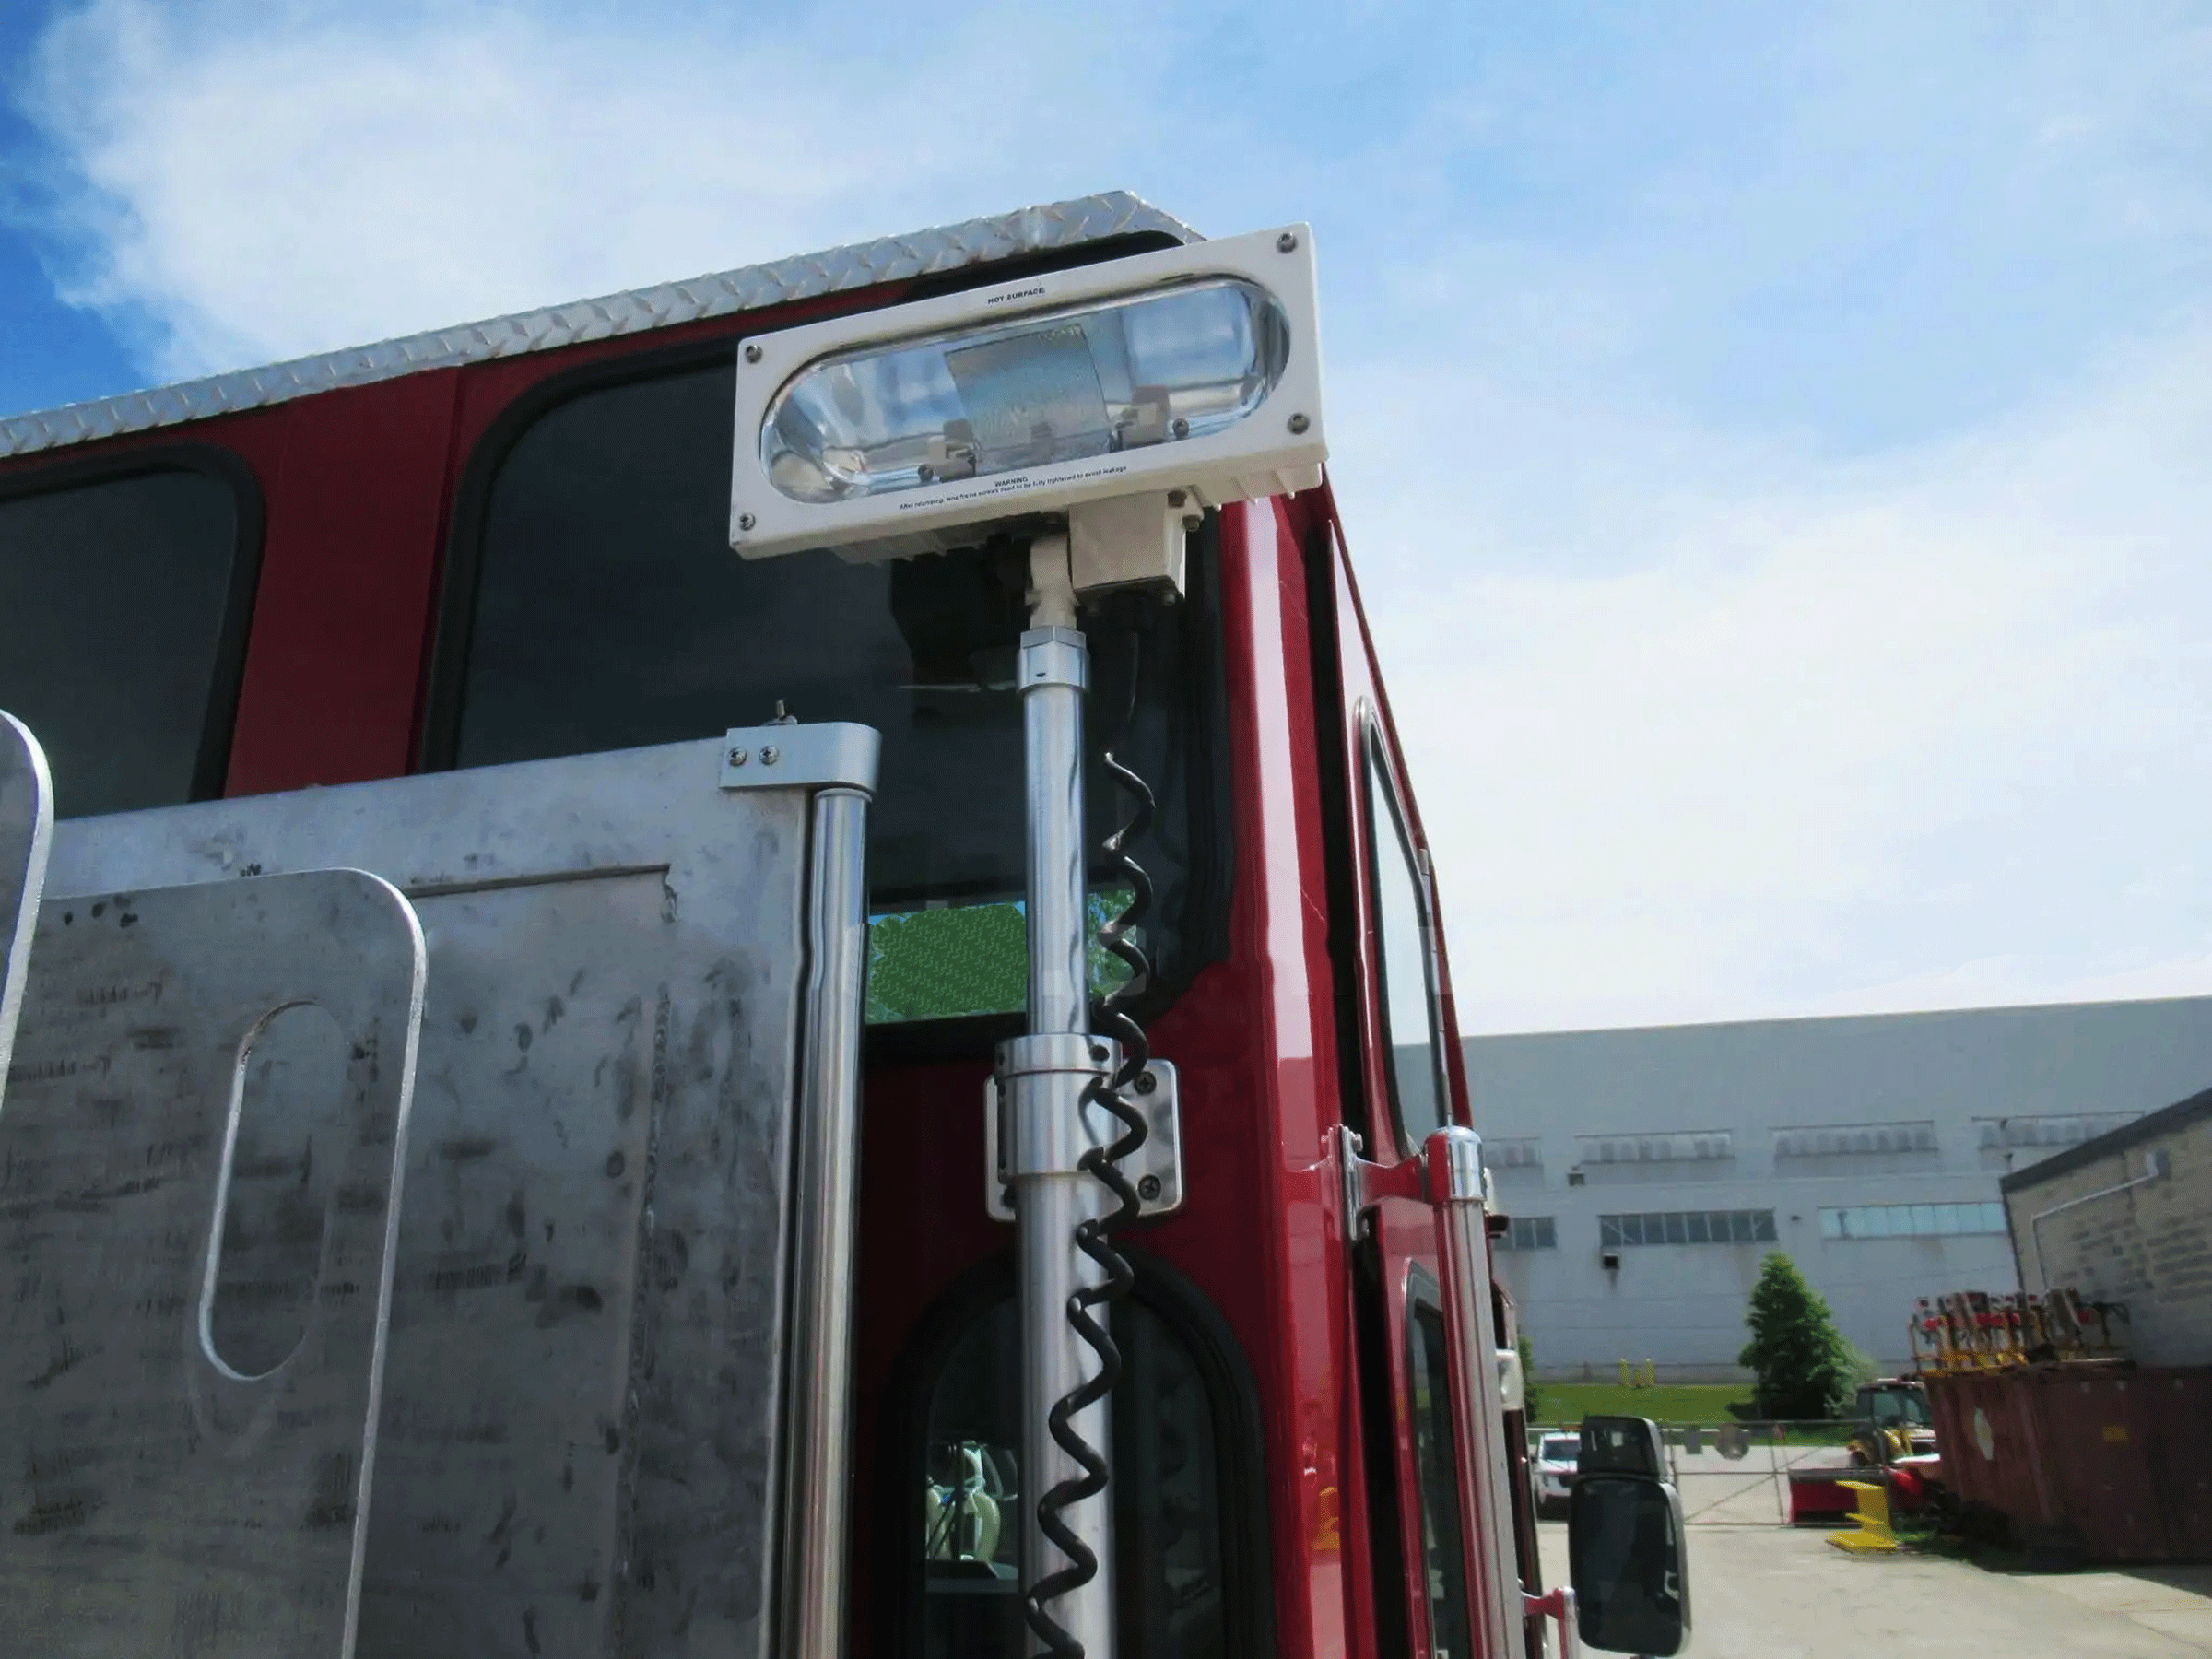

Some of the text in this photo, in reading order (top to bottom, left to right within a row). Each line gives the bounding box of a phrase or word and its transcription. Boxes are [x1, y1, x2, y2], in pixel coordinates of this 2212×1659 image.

[988, 287, 1045, 304] HOT SURFACE
[995, 476, 1029, 488] WARNING
